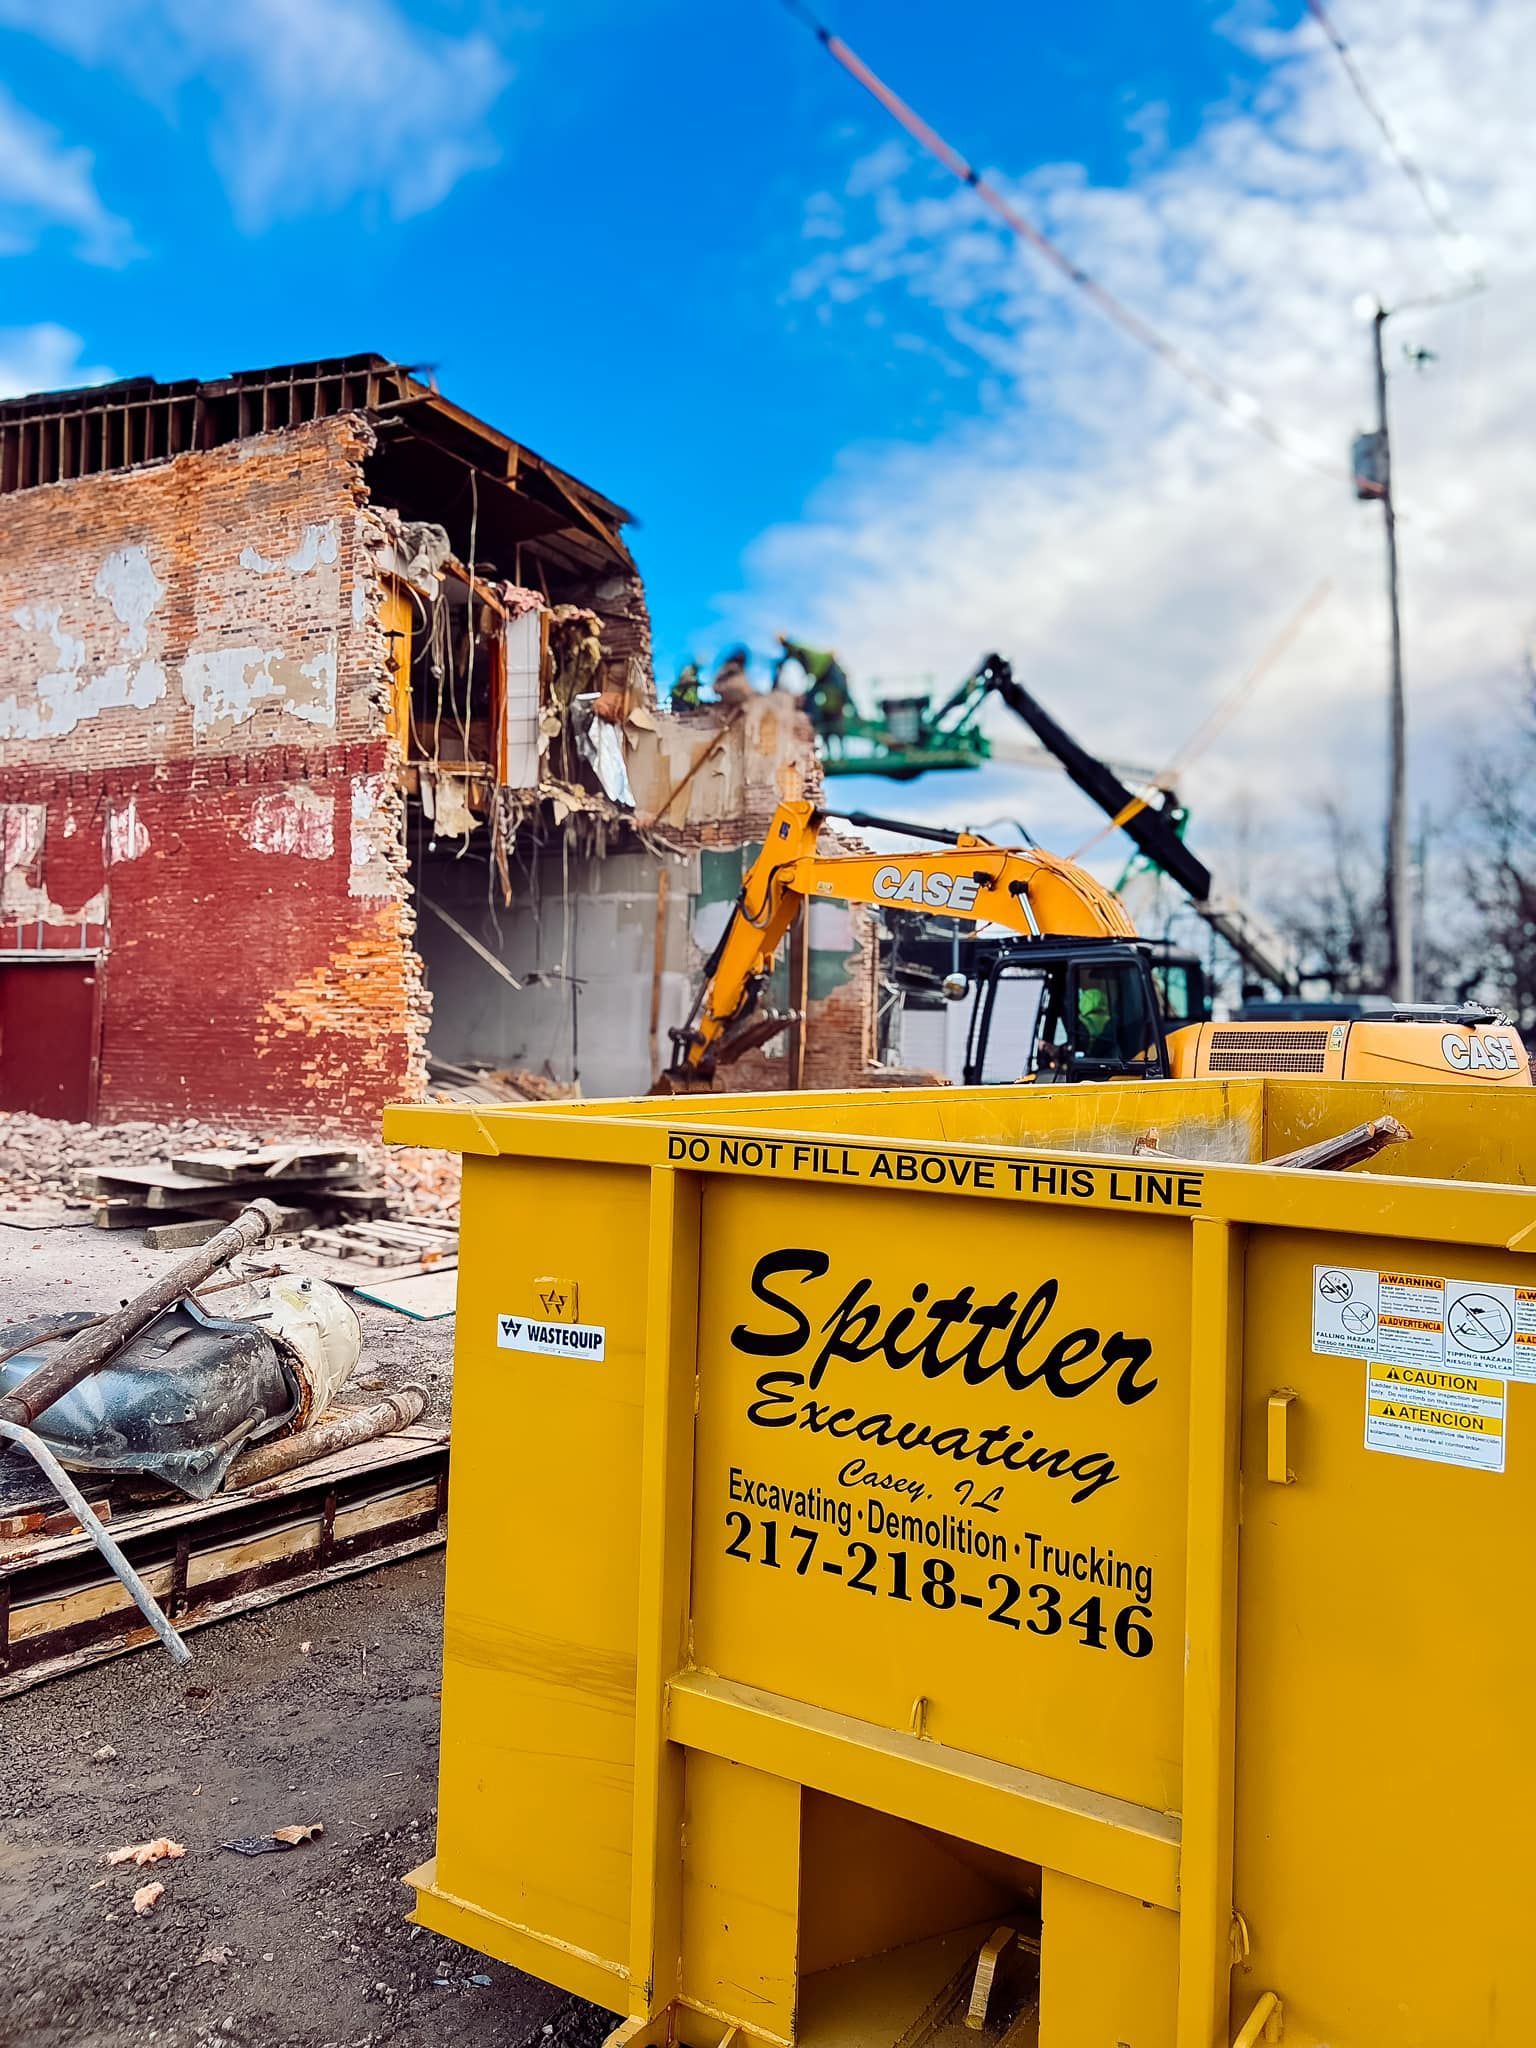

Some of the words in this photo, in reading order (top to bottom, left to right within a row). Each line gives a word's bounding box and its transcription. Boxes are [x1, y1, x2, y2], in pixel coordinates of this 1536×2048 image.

[873, 865, 981, 912] CASE
[1441, 1033, 1521, 1071] CASE
[667, 1136, 710, 1162] DO
[720, 1140, 784, 1169] NOT
[793, 1146, 860, 1176] FILL
[869, 1153, 995, 1189] ABOVE
[1007, 1164, 1095, 1198] THIS
[1109, 1172, 1203, 1208] LINE
[1388, 1275, 1442, 1289] WARNING
[527, 1324, 603, 1350] WASTEQUIP
[730, 1248, 1159, 1406] Spittler
[1316, 1331, 1345, 1340] FALLING
[1347, 1335, 1376, 1344] HAZARD
[1388, 1317, 1441, 1331] ADVERTENCIA
[1447, 1351, 1478, 1359] TIPPING
[1480, 1355, 1513, 1363] HAZARD
[1402, 1369, 1478, 1391] CAUTION
[1398, 1406, 1484, 1431] ATENCION
[747, 1371, 1120, 1504] Excavating
[953, 1479, 1005, 1513] IL
[725, 1511, 1154, 1658] 217-218-2346
[1024, 1532, 1152, 1604] Trucking
